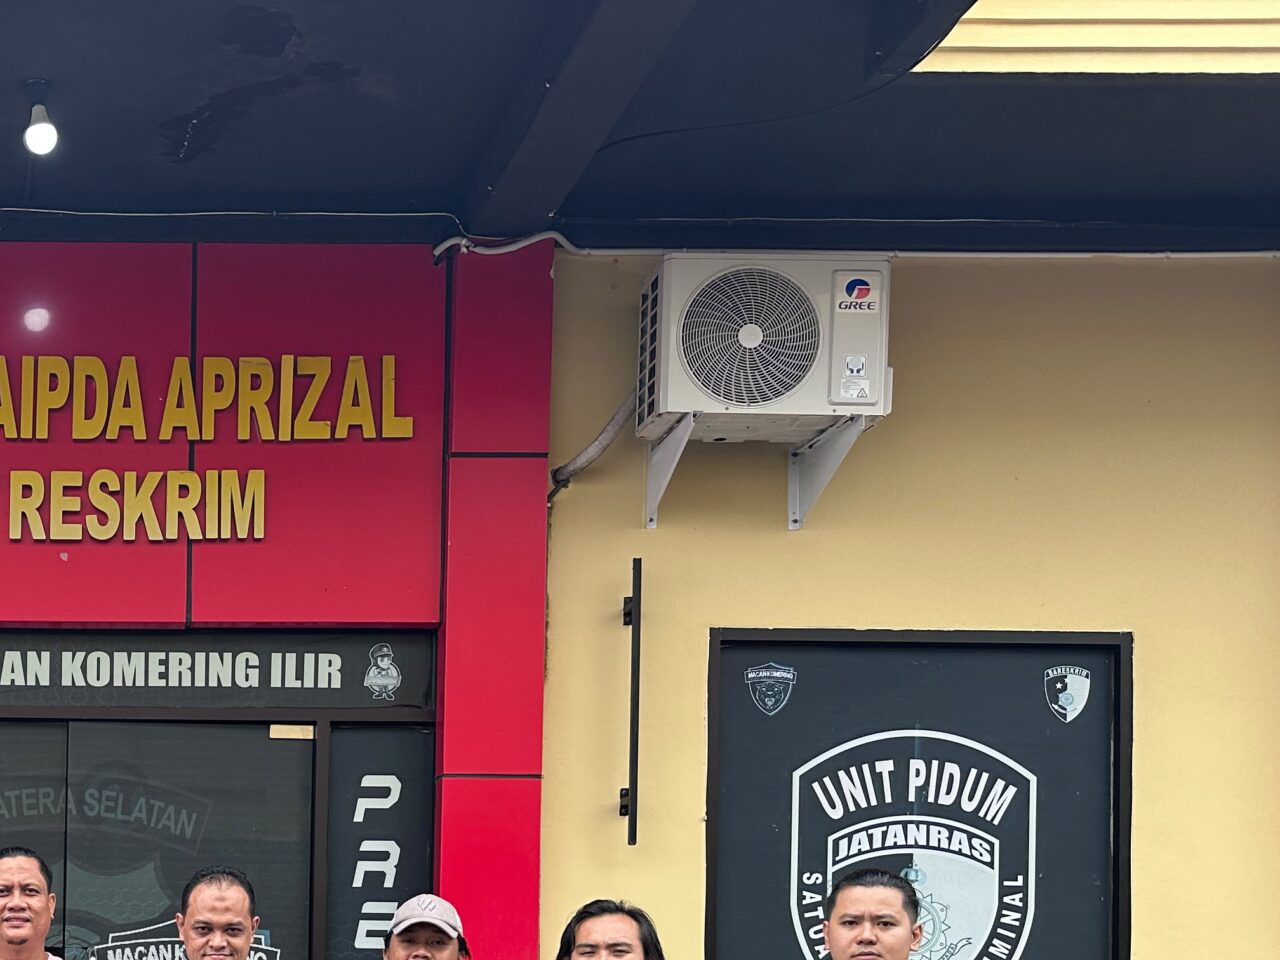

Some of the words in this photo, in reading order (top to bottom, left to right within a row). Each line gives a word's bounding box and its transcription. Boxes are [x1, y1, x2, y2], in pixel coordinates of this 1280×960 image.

[838, 300, 877, 311] GREE
[158, 354, 414, 442] APRIZAL
[9, 468, 265, 541] RESKRIM
[61, 650, 260, 688] KOMERING
[270, 652, 342, 689] ILIR
[83, 787, 198, 840] SELATAN
[811, 759, 895, 820] UNIT
[907, 758, 1018, 826] PIDUM
[835, 823, 992, 863] JATANRAS
